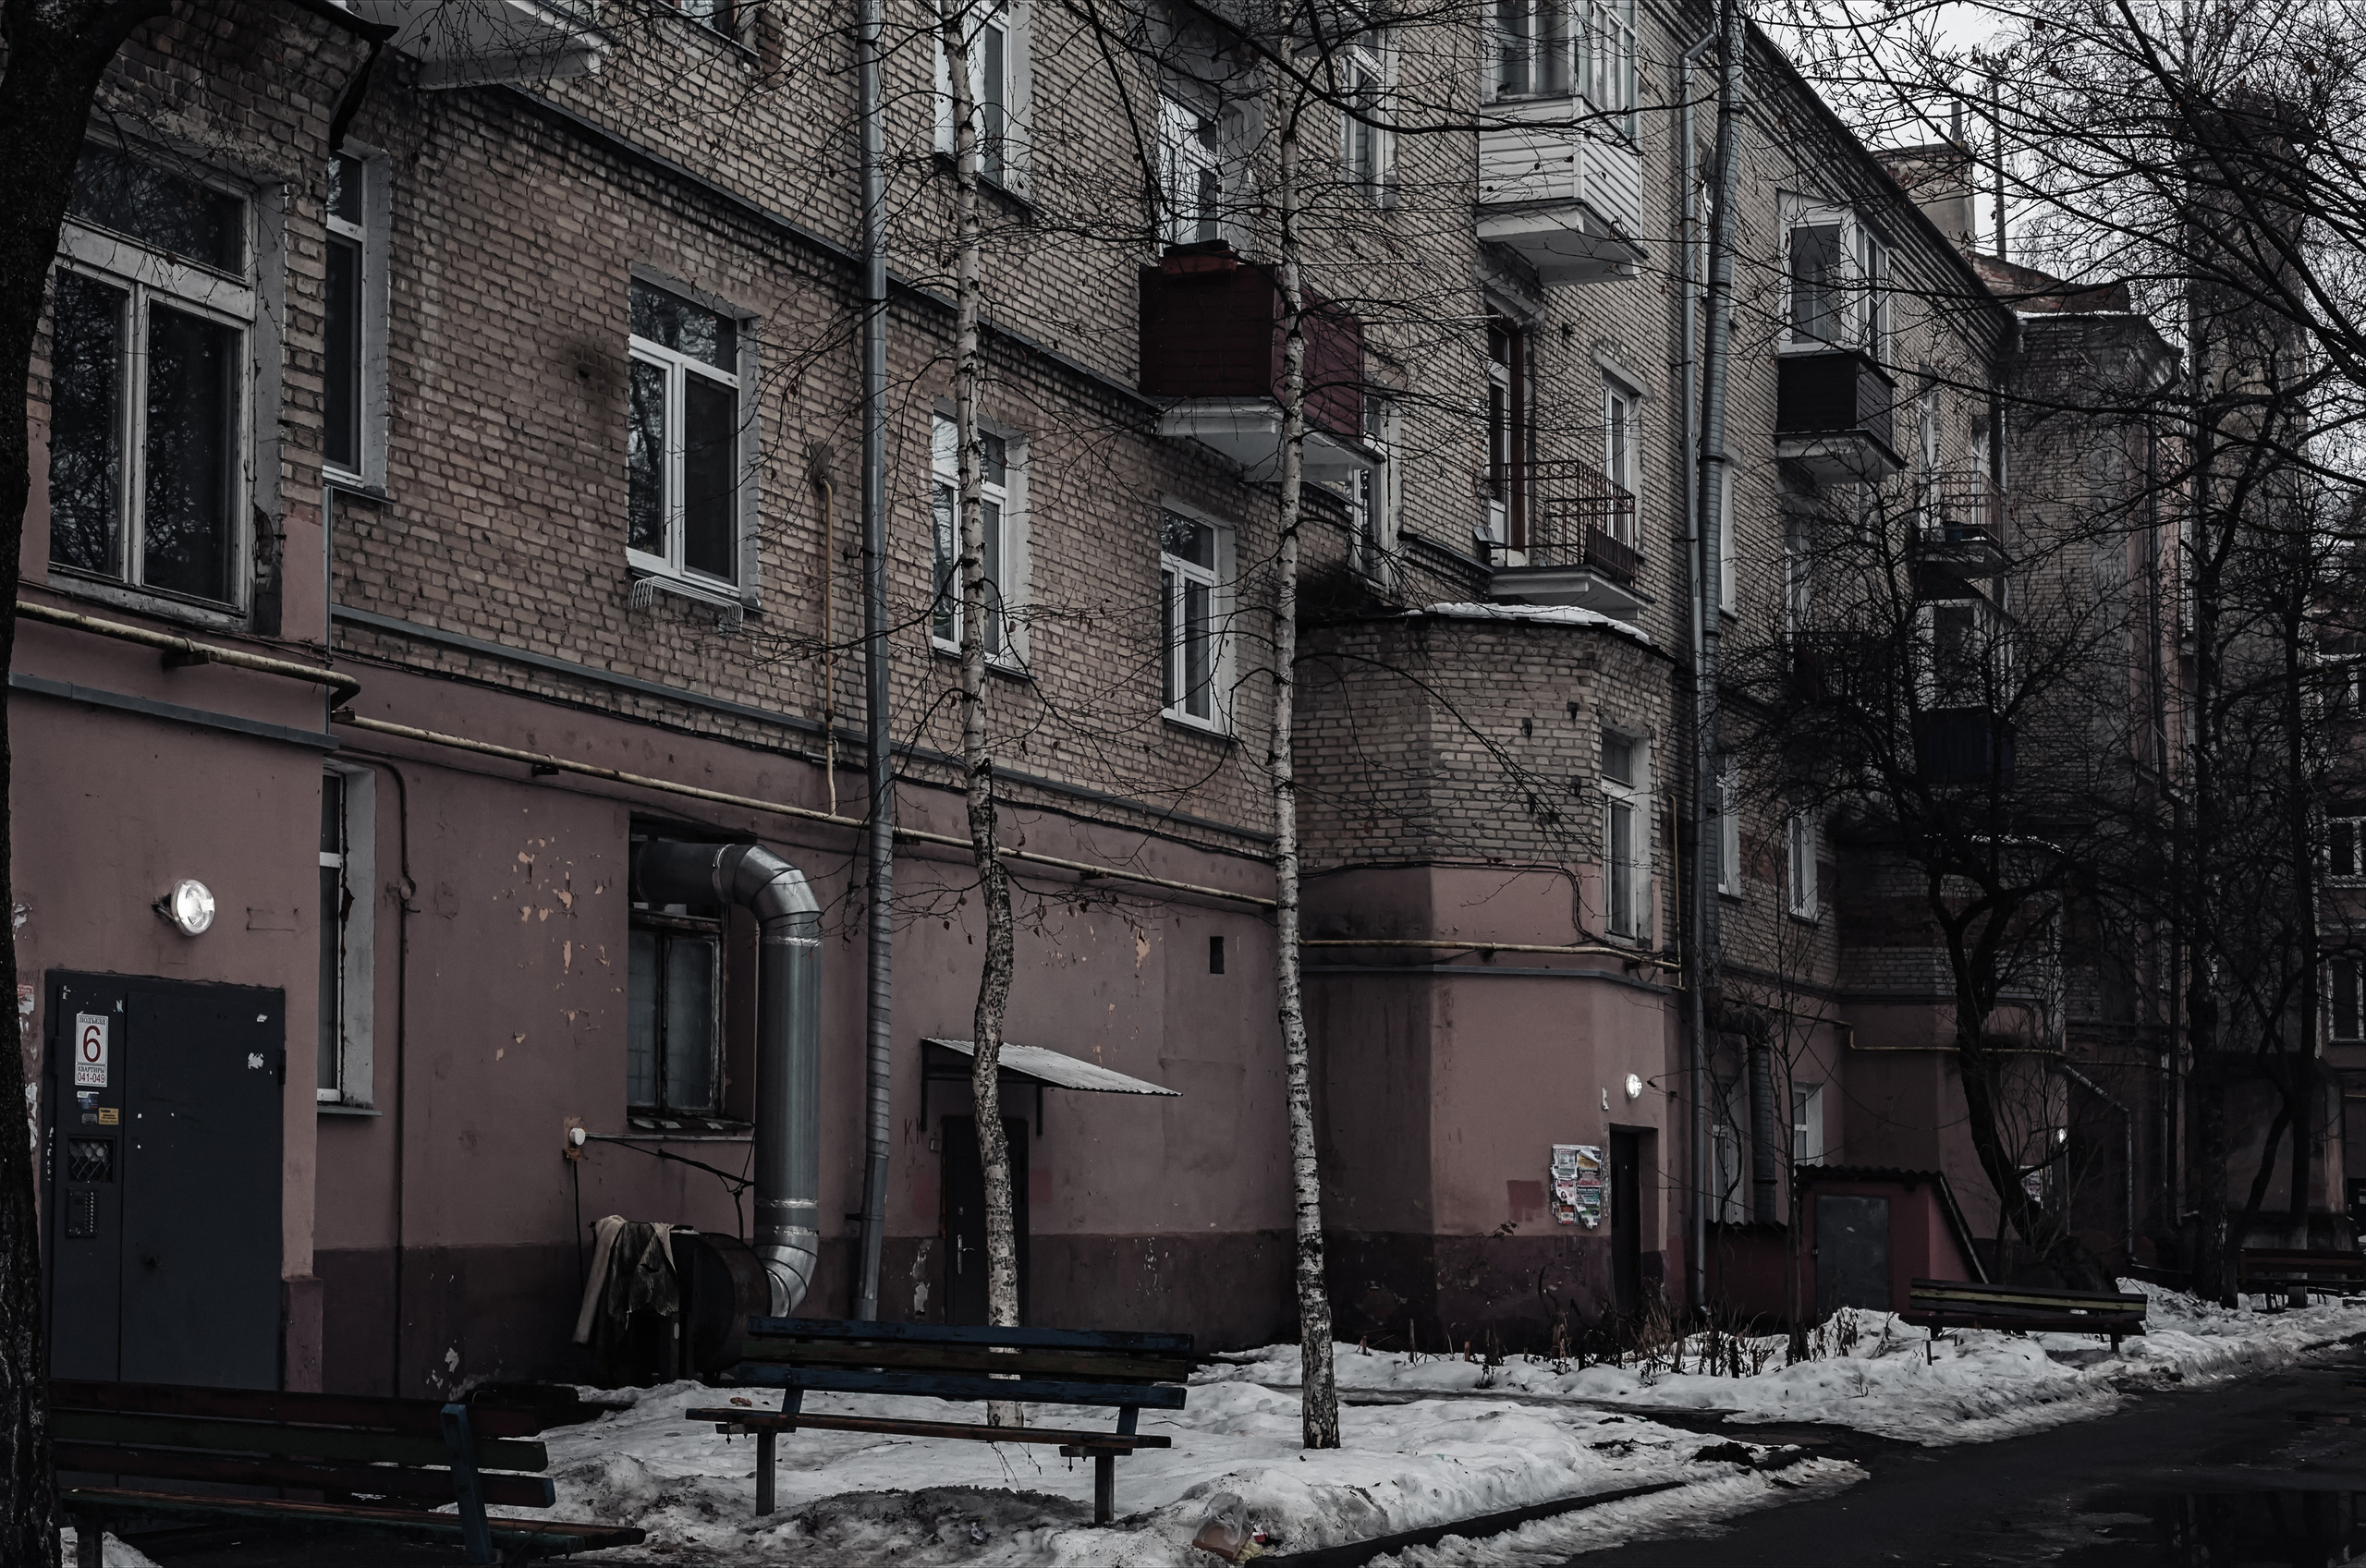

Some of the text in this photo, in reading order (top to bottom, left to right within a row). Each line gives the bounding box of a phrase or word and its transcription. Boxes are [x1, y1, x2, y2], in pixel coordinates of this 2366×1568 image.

[79, 1016, 105, 1026] ПОДЪЕЗД
[83, 1026, 101, 1063] 6
[78, 1065, 105, 1074] КВАРТИРЫ
[77, 1073, 105, 1084] 041-049
